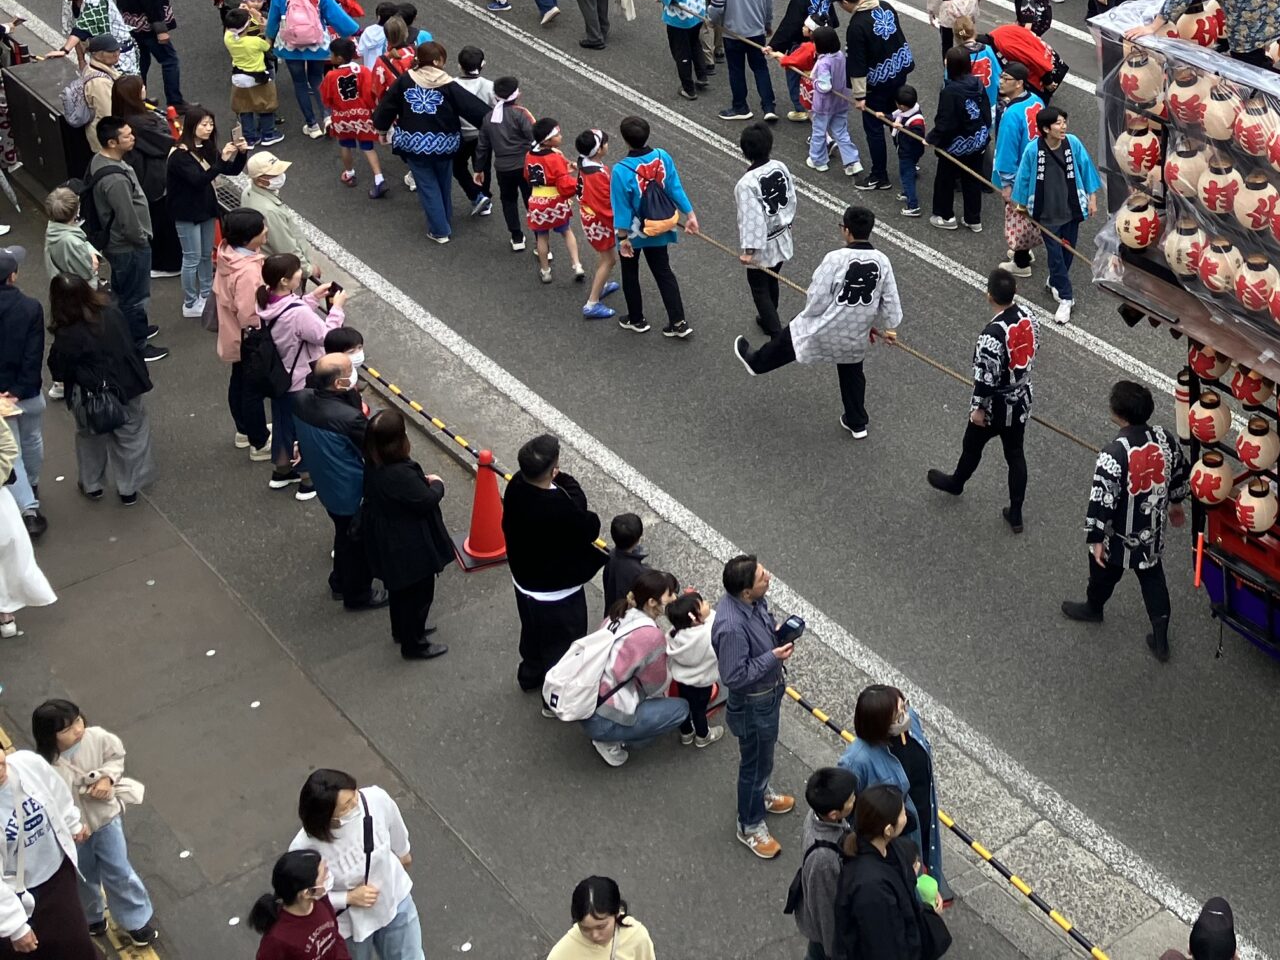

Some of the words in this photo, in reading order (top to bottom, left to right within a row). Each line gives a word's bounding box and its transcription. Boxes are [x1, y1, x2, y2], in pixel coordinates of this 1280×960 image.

[1204, 180, 1238, 210] 拝
[1235, 276, 1269, 309] 拝
[1232, 372, 1261, 404] 伏
[1190, 470, 1222, 503] 伏
